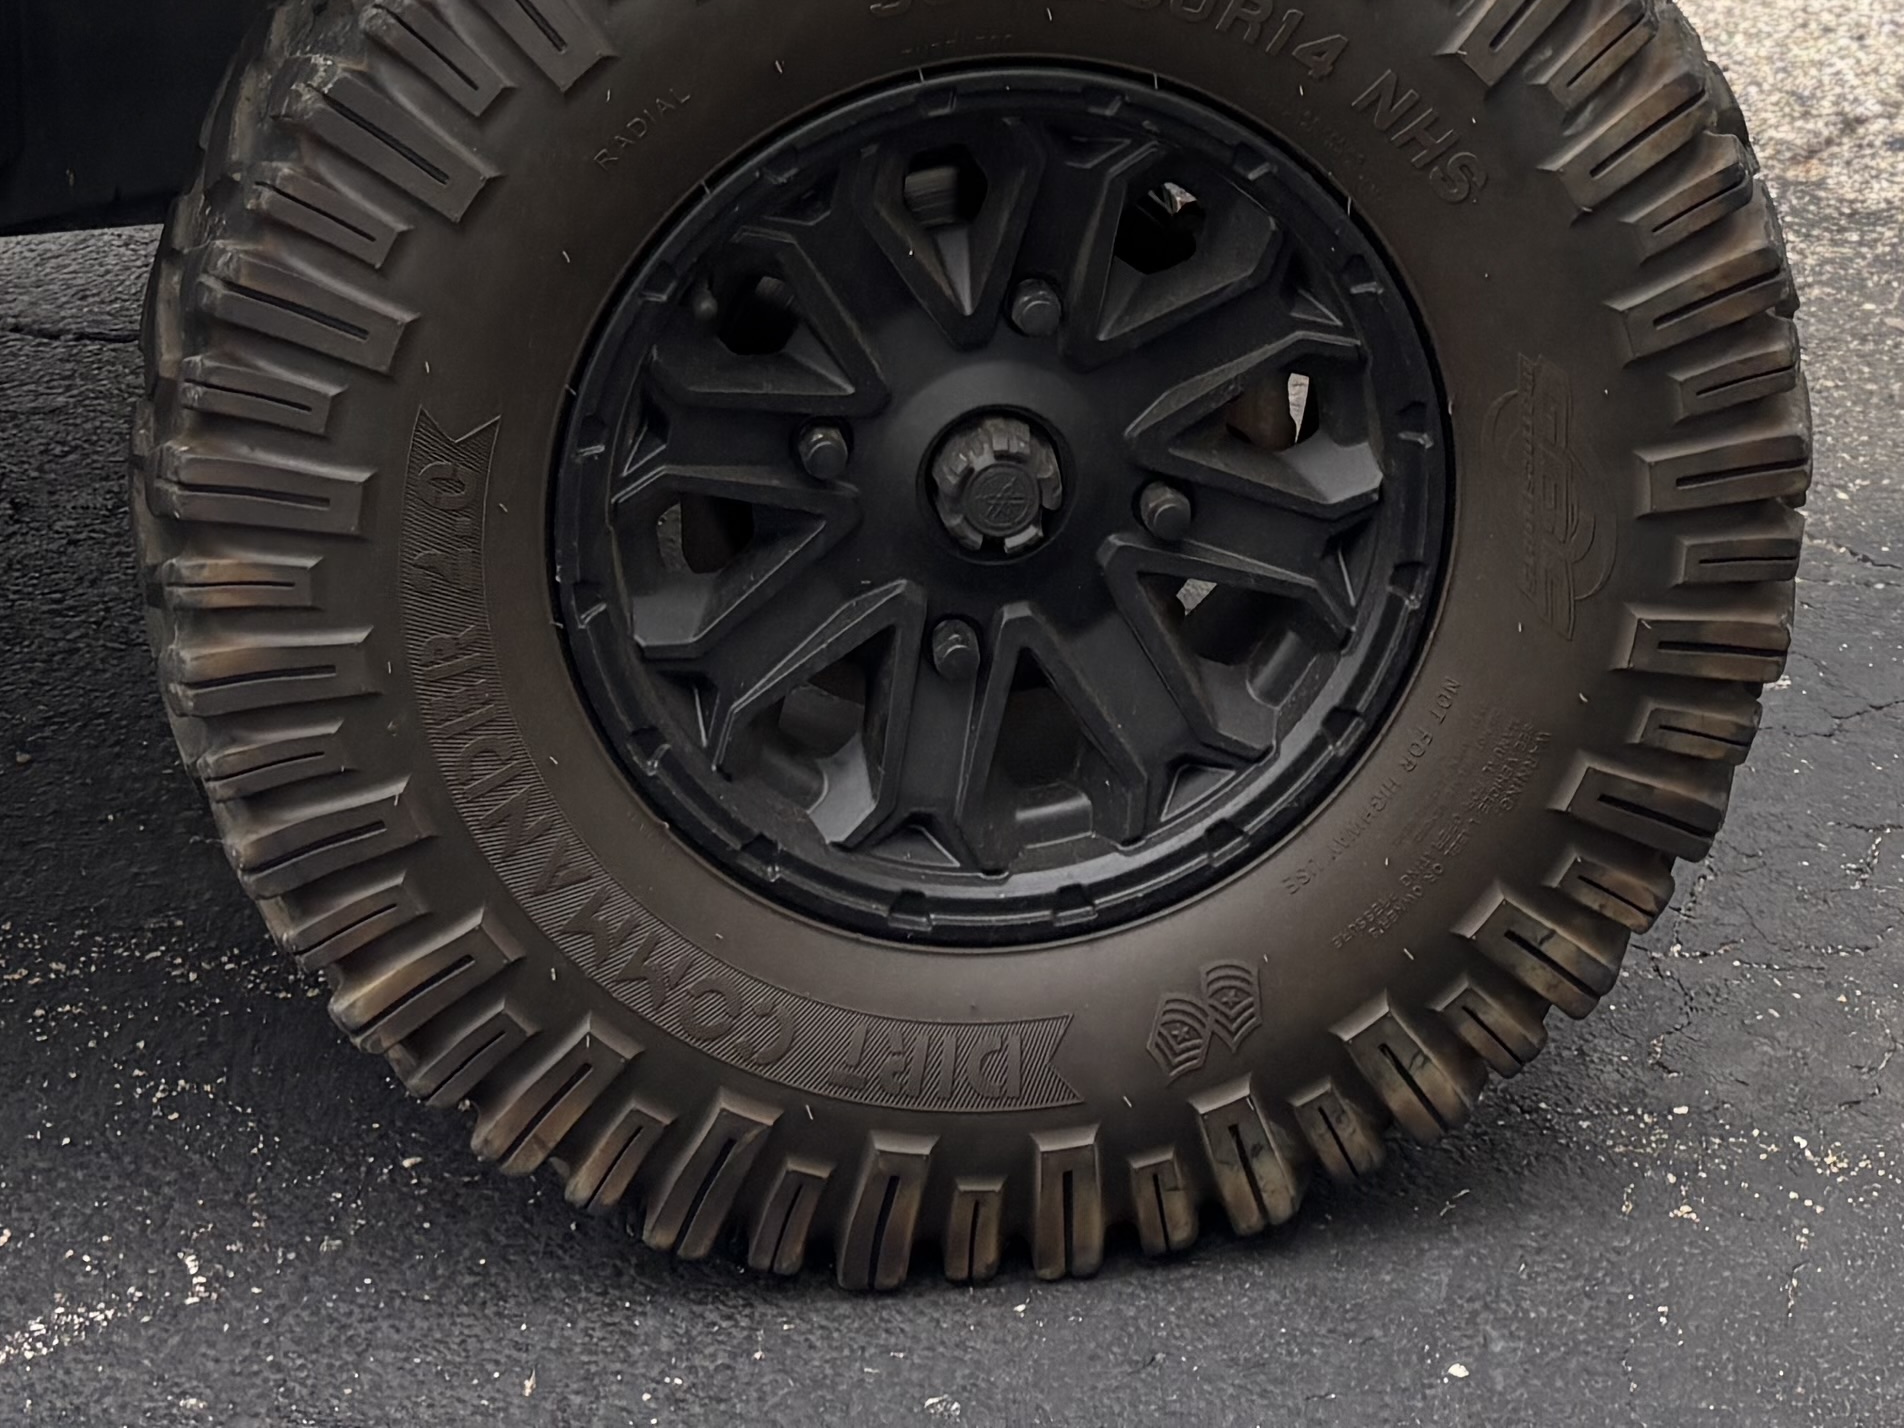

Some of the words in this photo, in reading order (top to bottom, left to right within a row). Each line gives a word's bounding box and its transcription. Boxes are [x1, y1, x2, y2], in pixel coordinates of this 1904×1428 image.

[592, 87, 693, 171] RADIAL
[1349, 68, 1490, 205] NHS
[410, 459, 479, 597] 2.0
[1425, 675, 1463, 727] NOT
[1395, 727, 1435, 776] FOR
[419, 624, 797, 1068] COMMANDER
[825, 1022, 1024, 1103] DIRT
